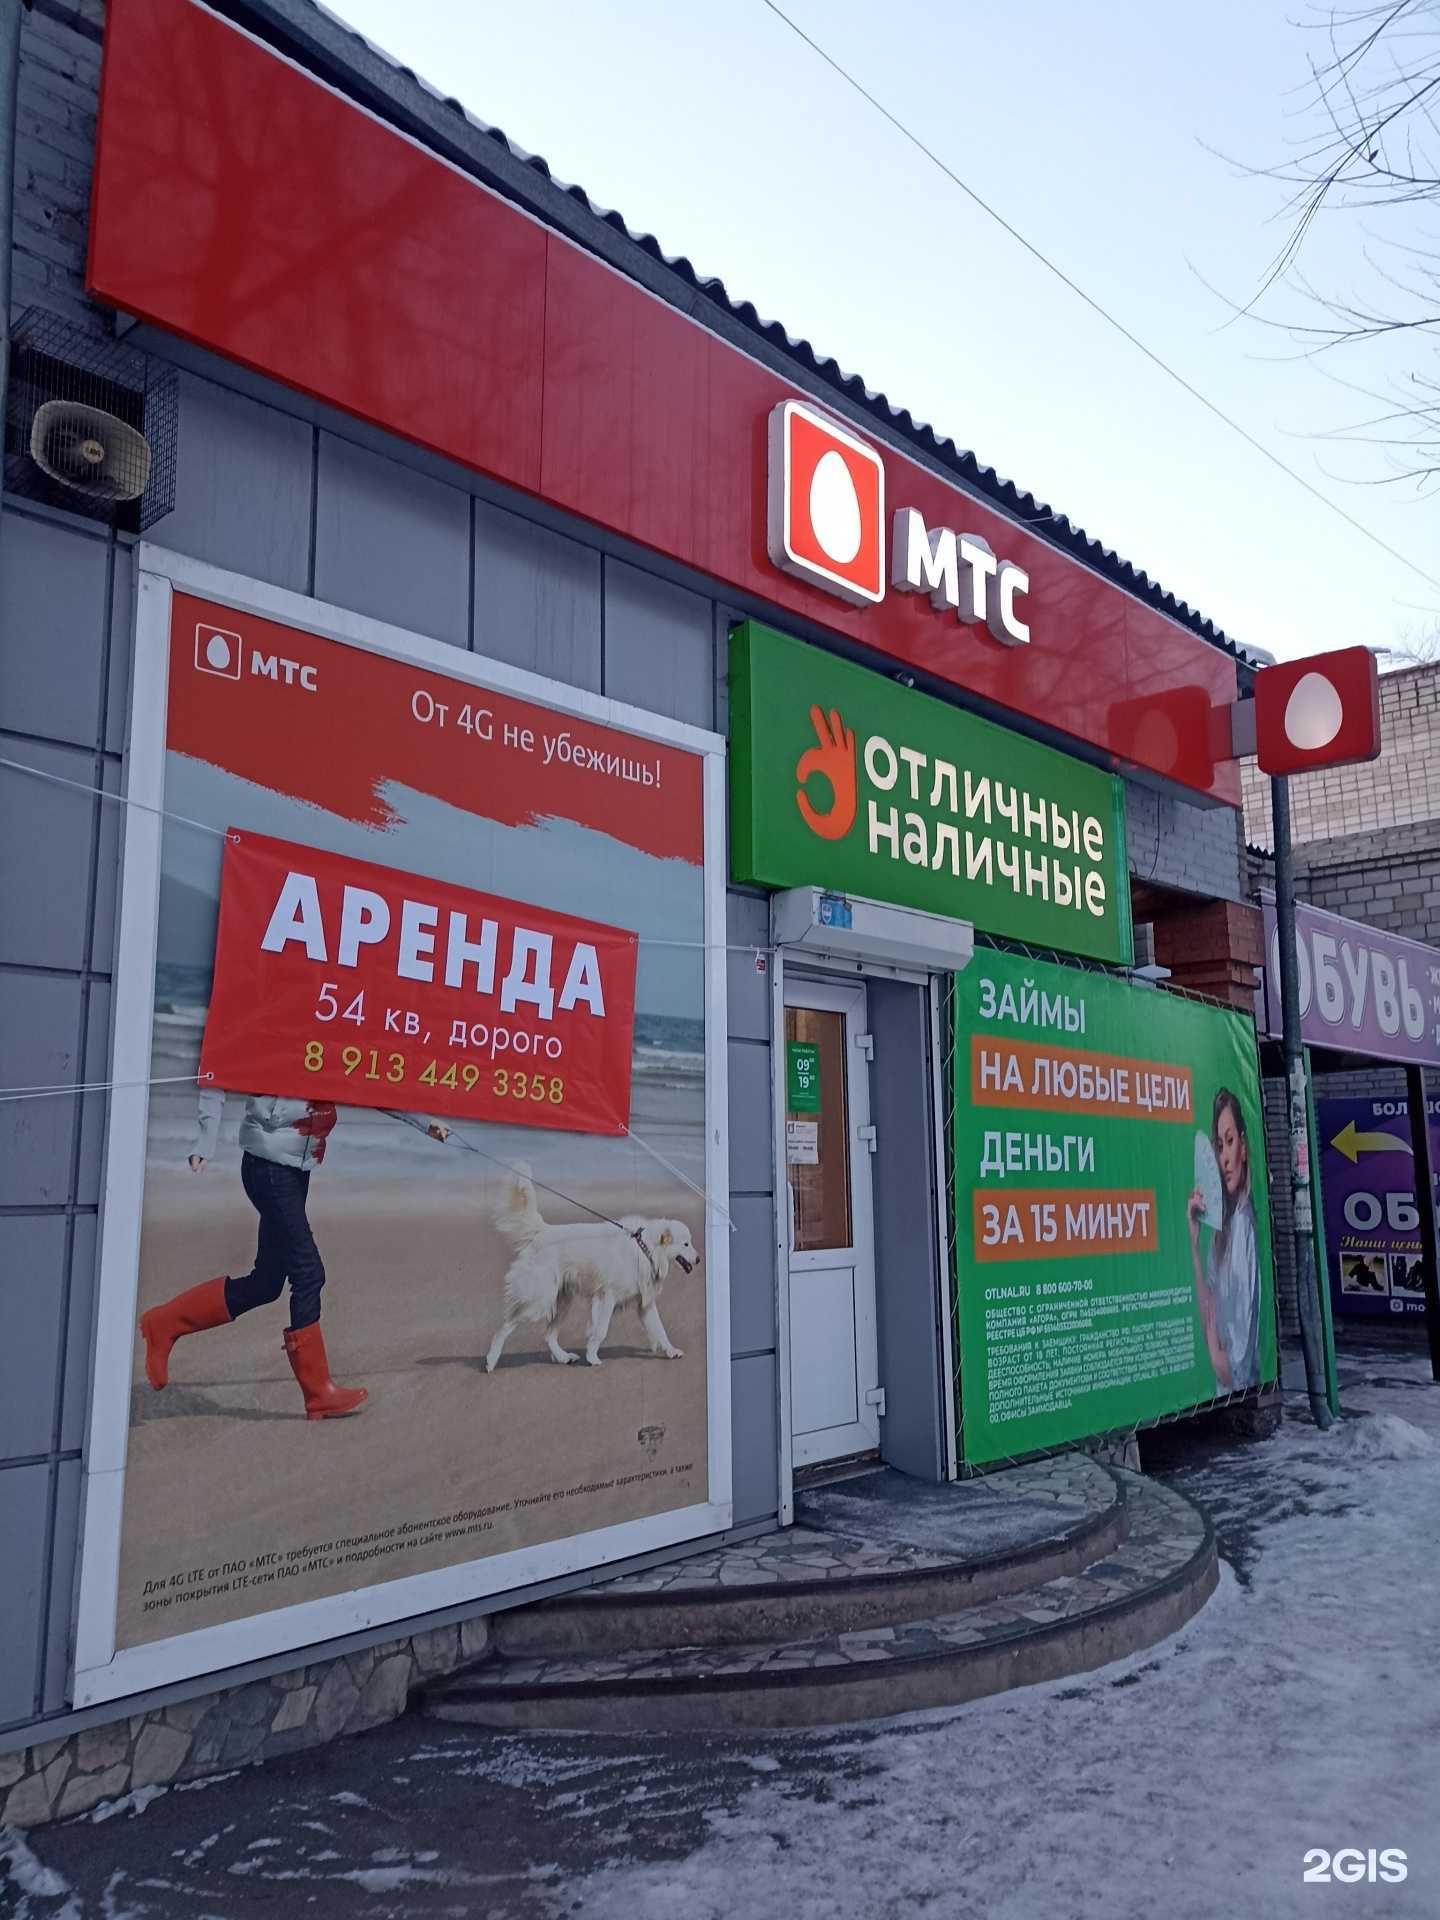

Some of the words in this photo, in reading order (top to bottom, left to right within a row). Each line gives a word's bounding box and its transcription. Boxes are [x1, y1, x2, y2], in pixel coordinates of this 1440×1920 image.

[904, 508, 1030, 643] МТС
[251, 650, 318, 692] МТС
[412, 690, 448, 728] От
[457, 704, 493, 740] 4G
[503, 721, 534, 753] не
[543, 732, 662, 789] убежишь!
[260, 871, 605, 1020] АРЕНДА
[315, 983, 366, 1026] 54
[384, 1008, 431, 1044] кв,
[448, 1020, 562, 1059] дорого
[979, 978, 1085, 1034] ЗАЙМЫ
[304, 1041, 324, 1072] 8
[342, 1046, 405, 1083] 913
[419, 1059, 479, 1092] 449
[492, 1069, 564, 1104] 3358
[980, 1051, 1024, 1092] НА
[1031, 1057, 1130, 1104] ЛЮБЫЕ
[1135, 1071, 1190, 1112] ЦЕЛИ
[980, 1131, 1095, 1178] ДЕНЬГИ
[982, 1204, 1024, 1245] ЗА
[1030, 1204, 1058, 1242] 15
[1065, 1202, 1150, 1241] МИНУТ
[985, 1285, 1031, 1300] OTLNAL.RU
[1043, 1282, 1057, 1295] 800
[985, 1306, 1026, 1319] ОБЩЕСТВО
[142, 1578, 166, 1597] Для
[169, 1572, 184, 1587] 4G
[188, 1568, 205, 1583] LTE
[207, 1567, 220, 1579] от
[222, 1560, 246, 1577] ПАО
[250, 1552, 283, 1571] «МТС»
[285, 1541, 333, 1566] требуется
[335, 1526, 395, 1551] специальное
[398, 1515, 451, 1536] абонентское
[453, 1502, 512, 1522] оборудование.
[143, 1597, 172, 1613] зоны
[175, 1582, 229, 1606] покрытия
[233, 1571, 274, 1591] LTE-сети
[277, 1565, 299, 1579] ПАО
[302, 1557, 334, 1574] «МТС»
[336, 1555, 343, 1565] и
[345, 1540, 405, 1563] подробности
[407, 1538, 418, 1548] на
[419, 1532, 444, 1547] сайте
